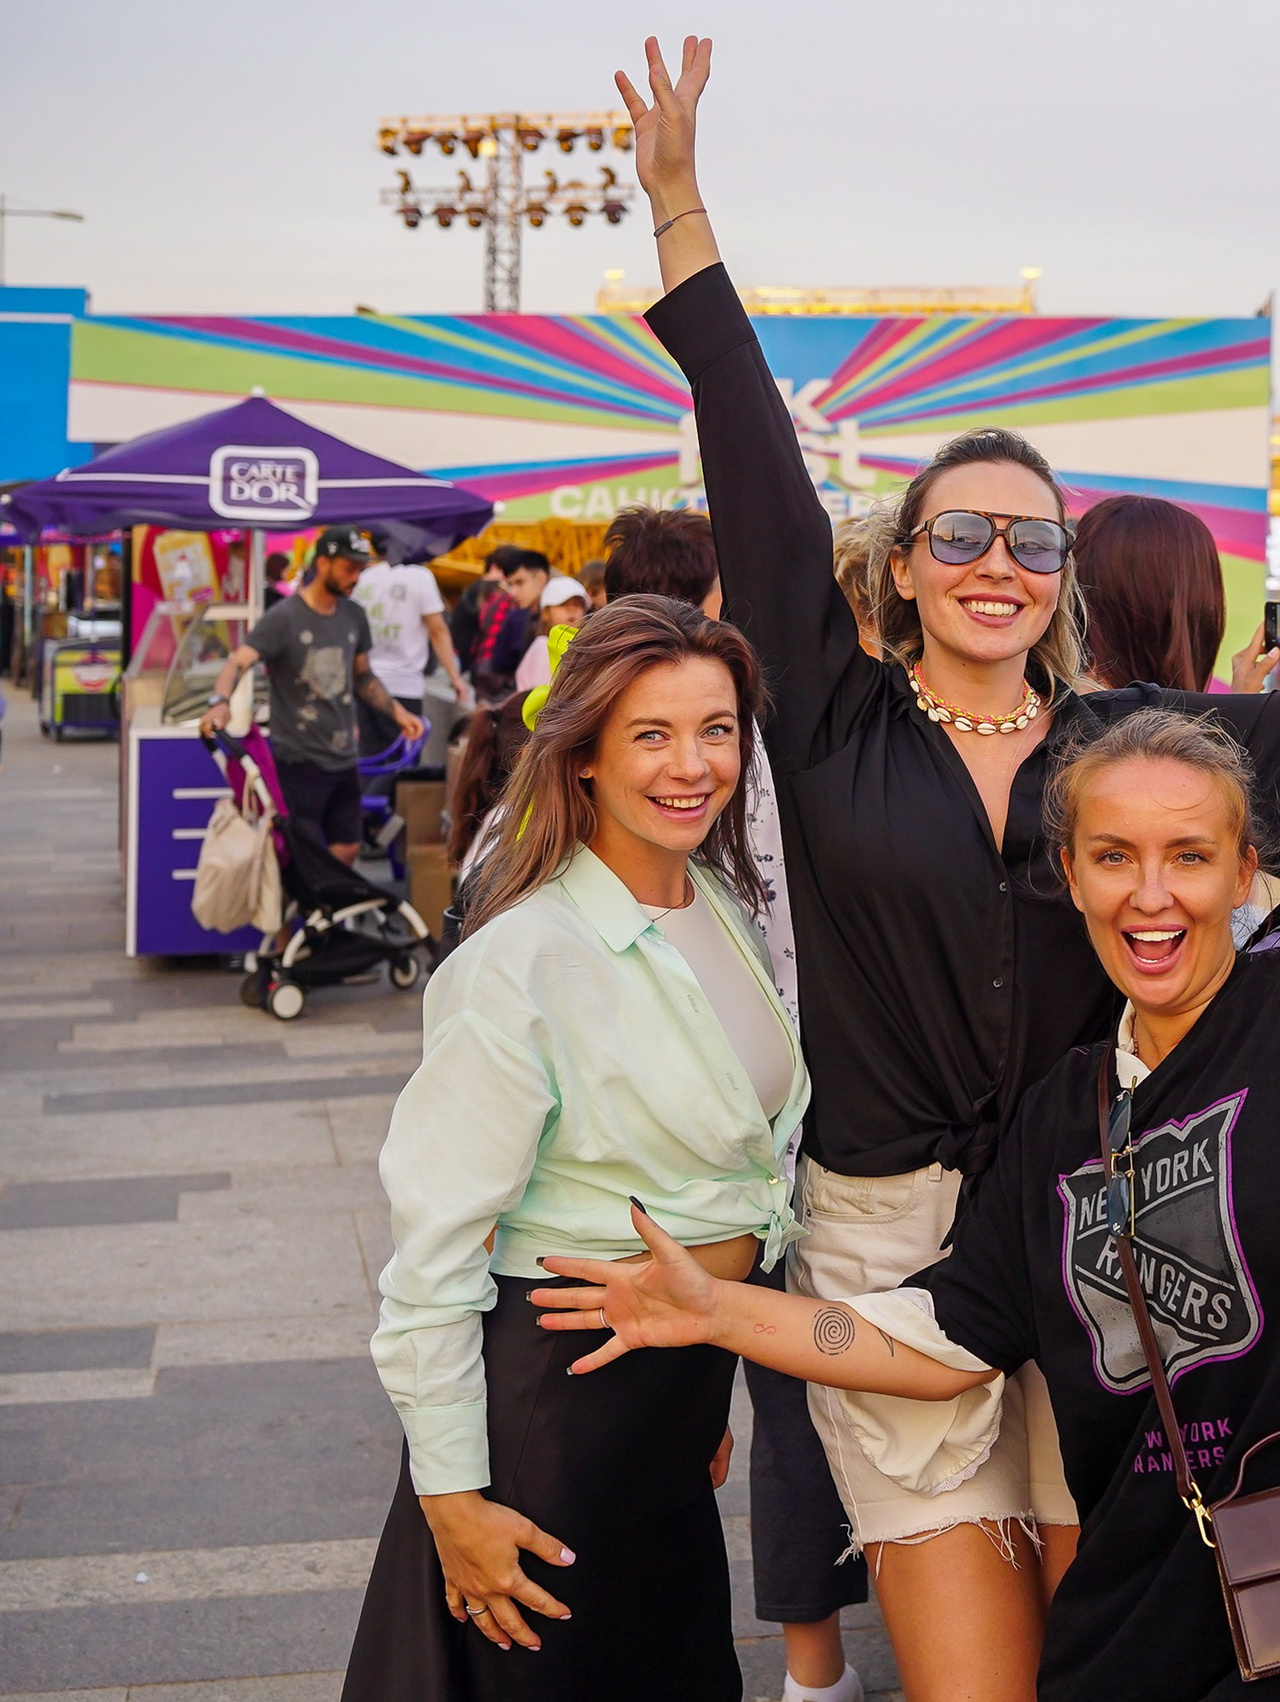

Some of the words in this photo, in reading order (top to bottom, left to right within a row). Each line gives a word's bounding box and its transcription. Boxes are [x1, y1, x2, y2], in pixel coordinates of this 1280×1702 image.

[230, 462, 299, 482] CARTE
[1141, 1138, 1212, 1201] YORK
[1180, 1417, 1233, 1443] YORK
[1134, 1446, 1225, 1474] RANERS
